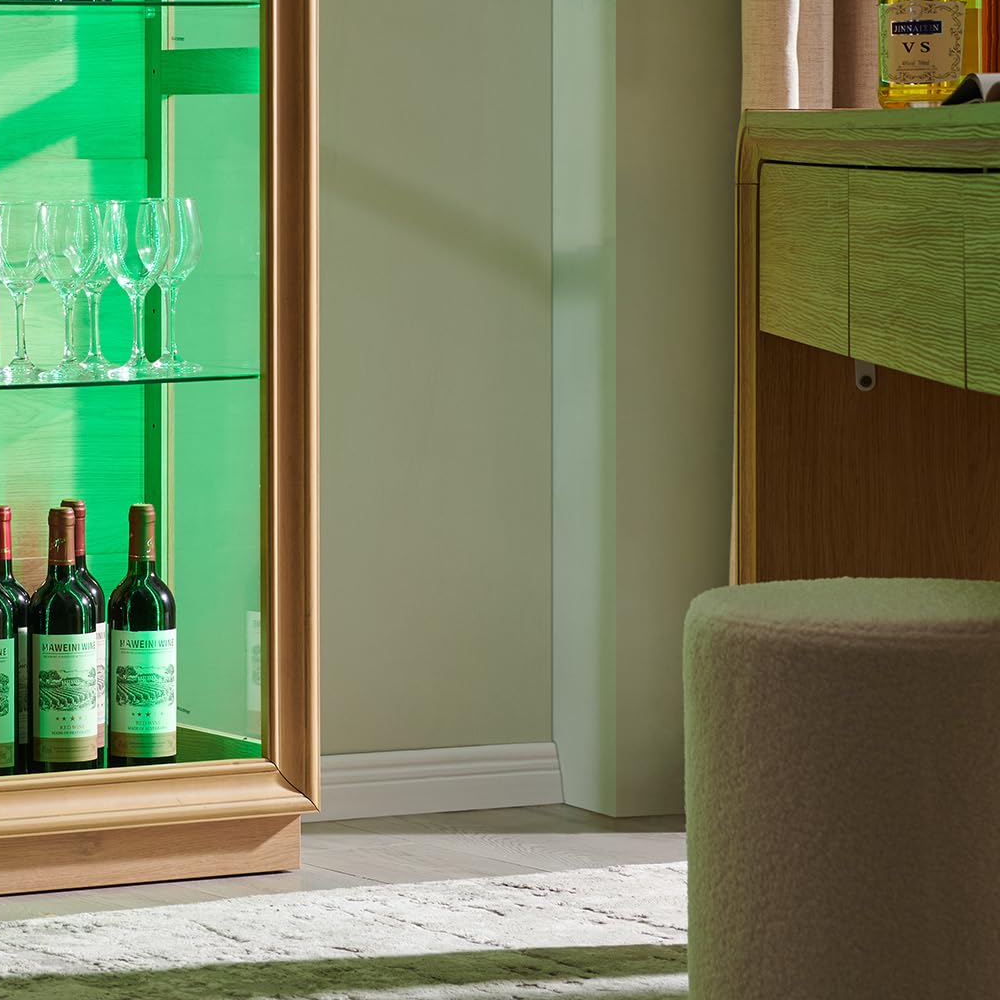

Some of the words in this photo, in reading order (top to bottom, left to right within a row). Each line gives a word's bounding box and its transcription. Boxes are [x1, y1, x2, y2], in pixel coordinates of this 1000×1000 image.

[42, 643, 80, 652] MAWEINI
[81, 641, 96, 651] WINE
[119, 639, 157, 649] MAWEINI
[158, 638, 175, 648] WINE
